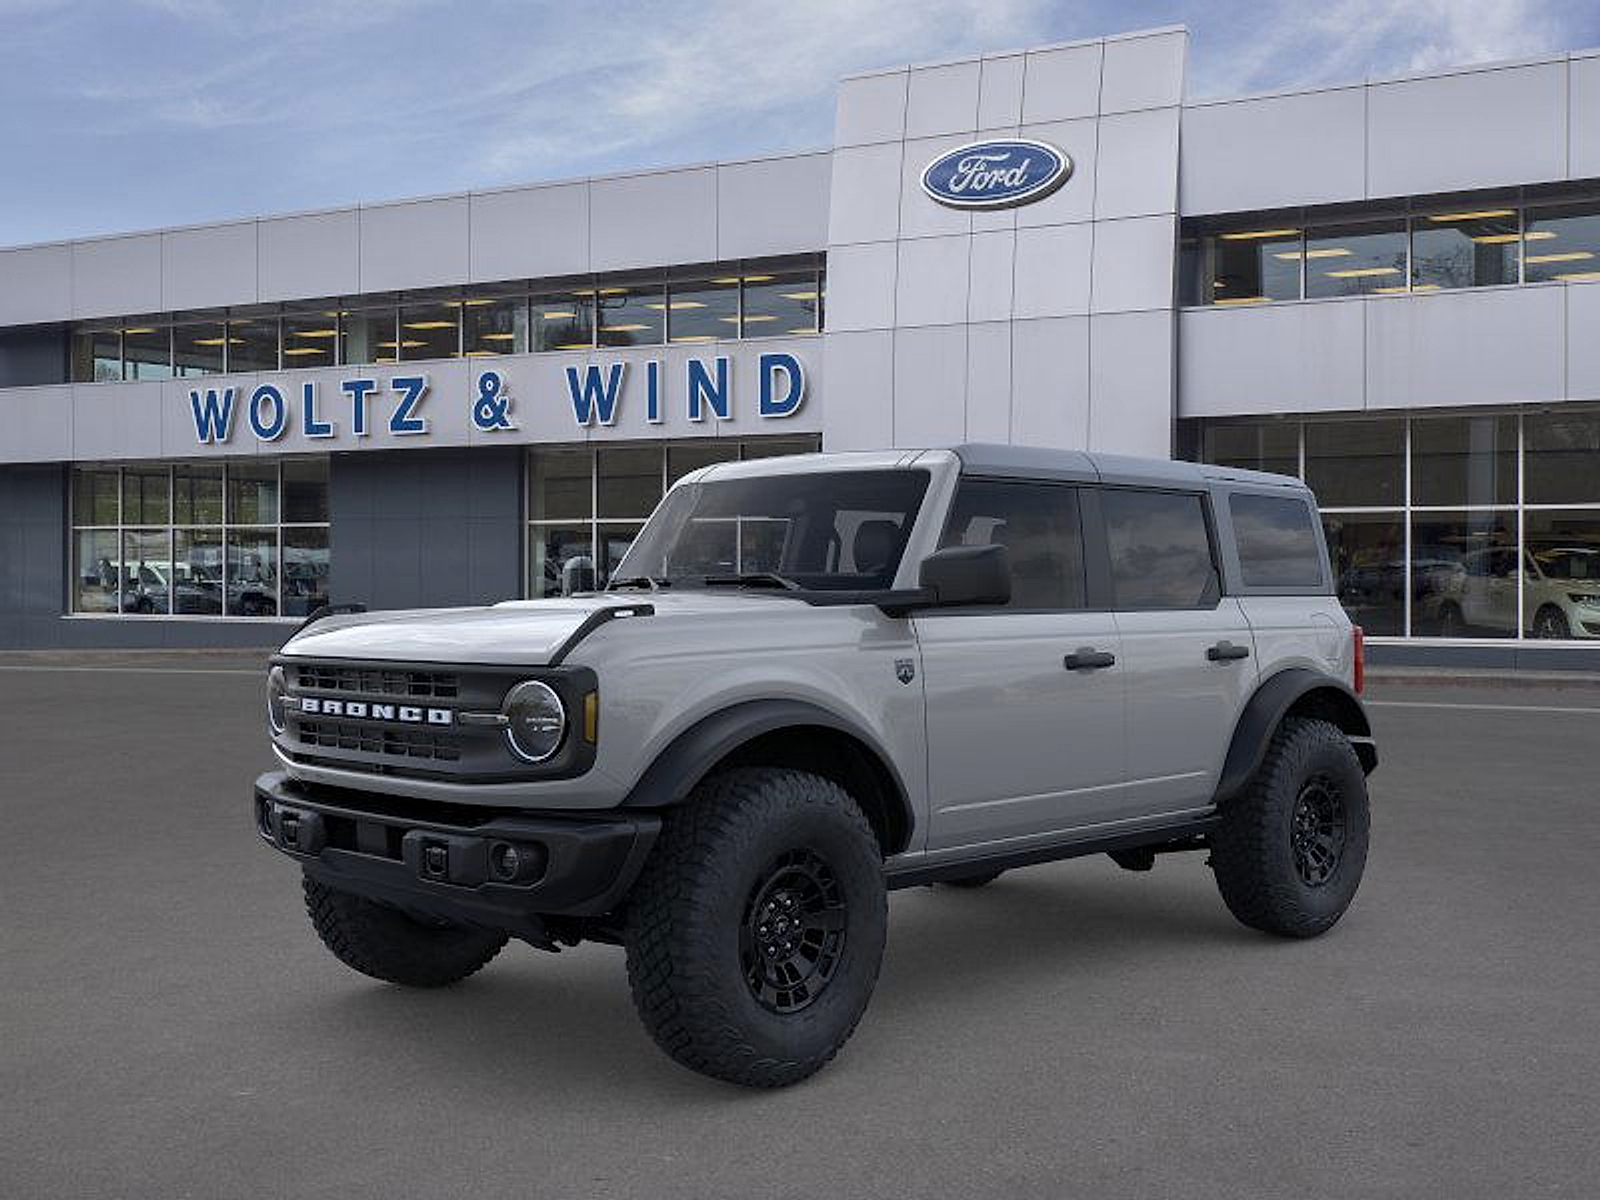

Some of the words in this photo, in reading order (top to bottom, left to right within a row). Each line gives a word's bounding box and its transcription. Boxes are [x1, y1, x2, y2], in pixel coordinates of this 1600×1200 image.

[950, 152, 1031, 193] Ford
[190, 377, 429, 443] WOLTZ
[472, 371, 514, 430] &
[566, 353, 805, 426] WIND
[302, 698, 452, 724] BRONCO
